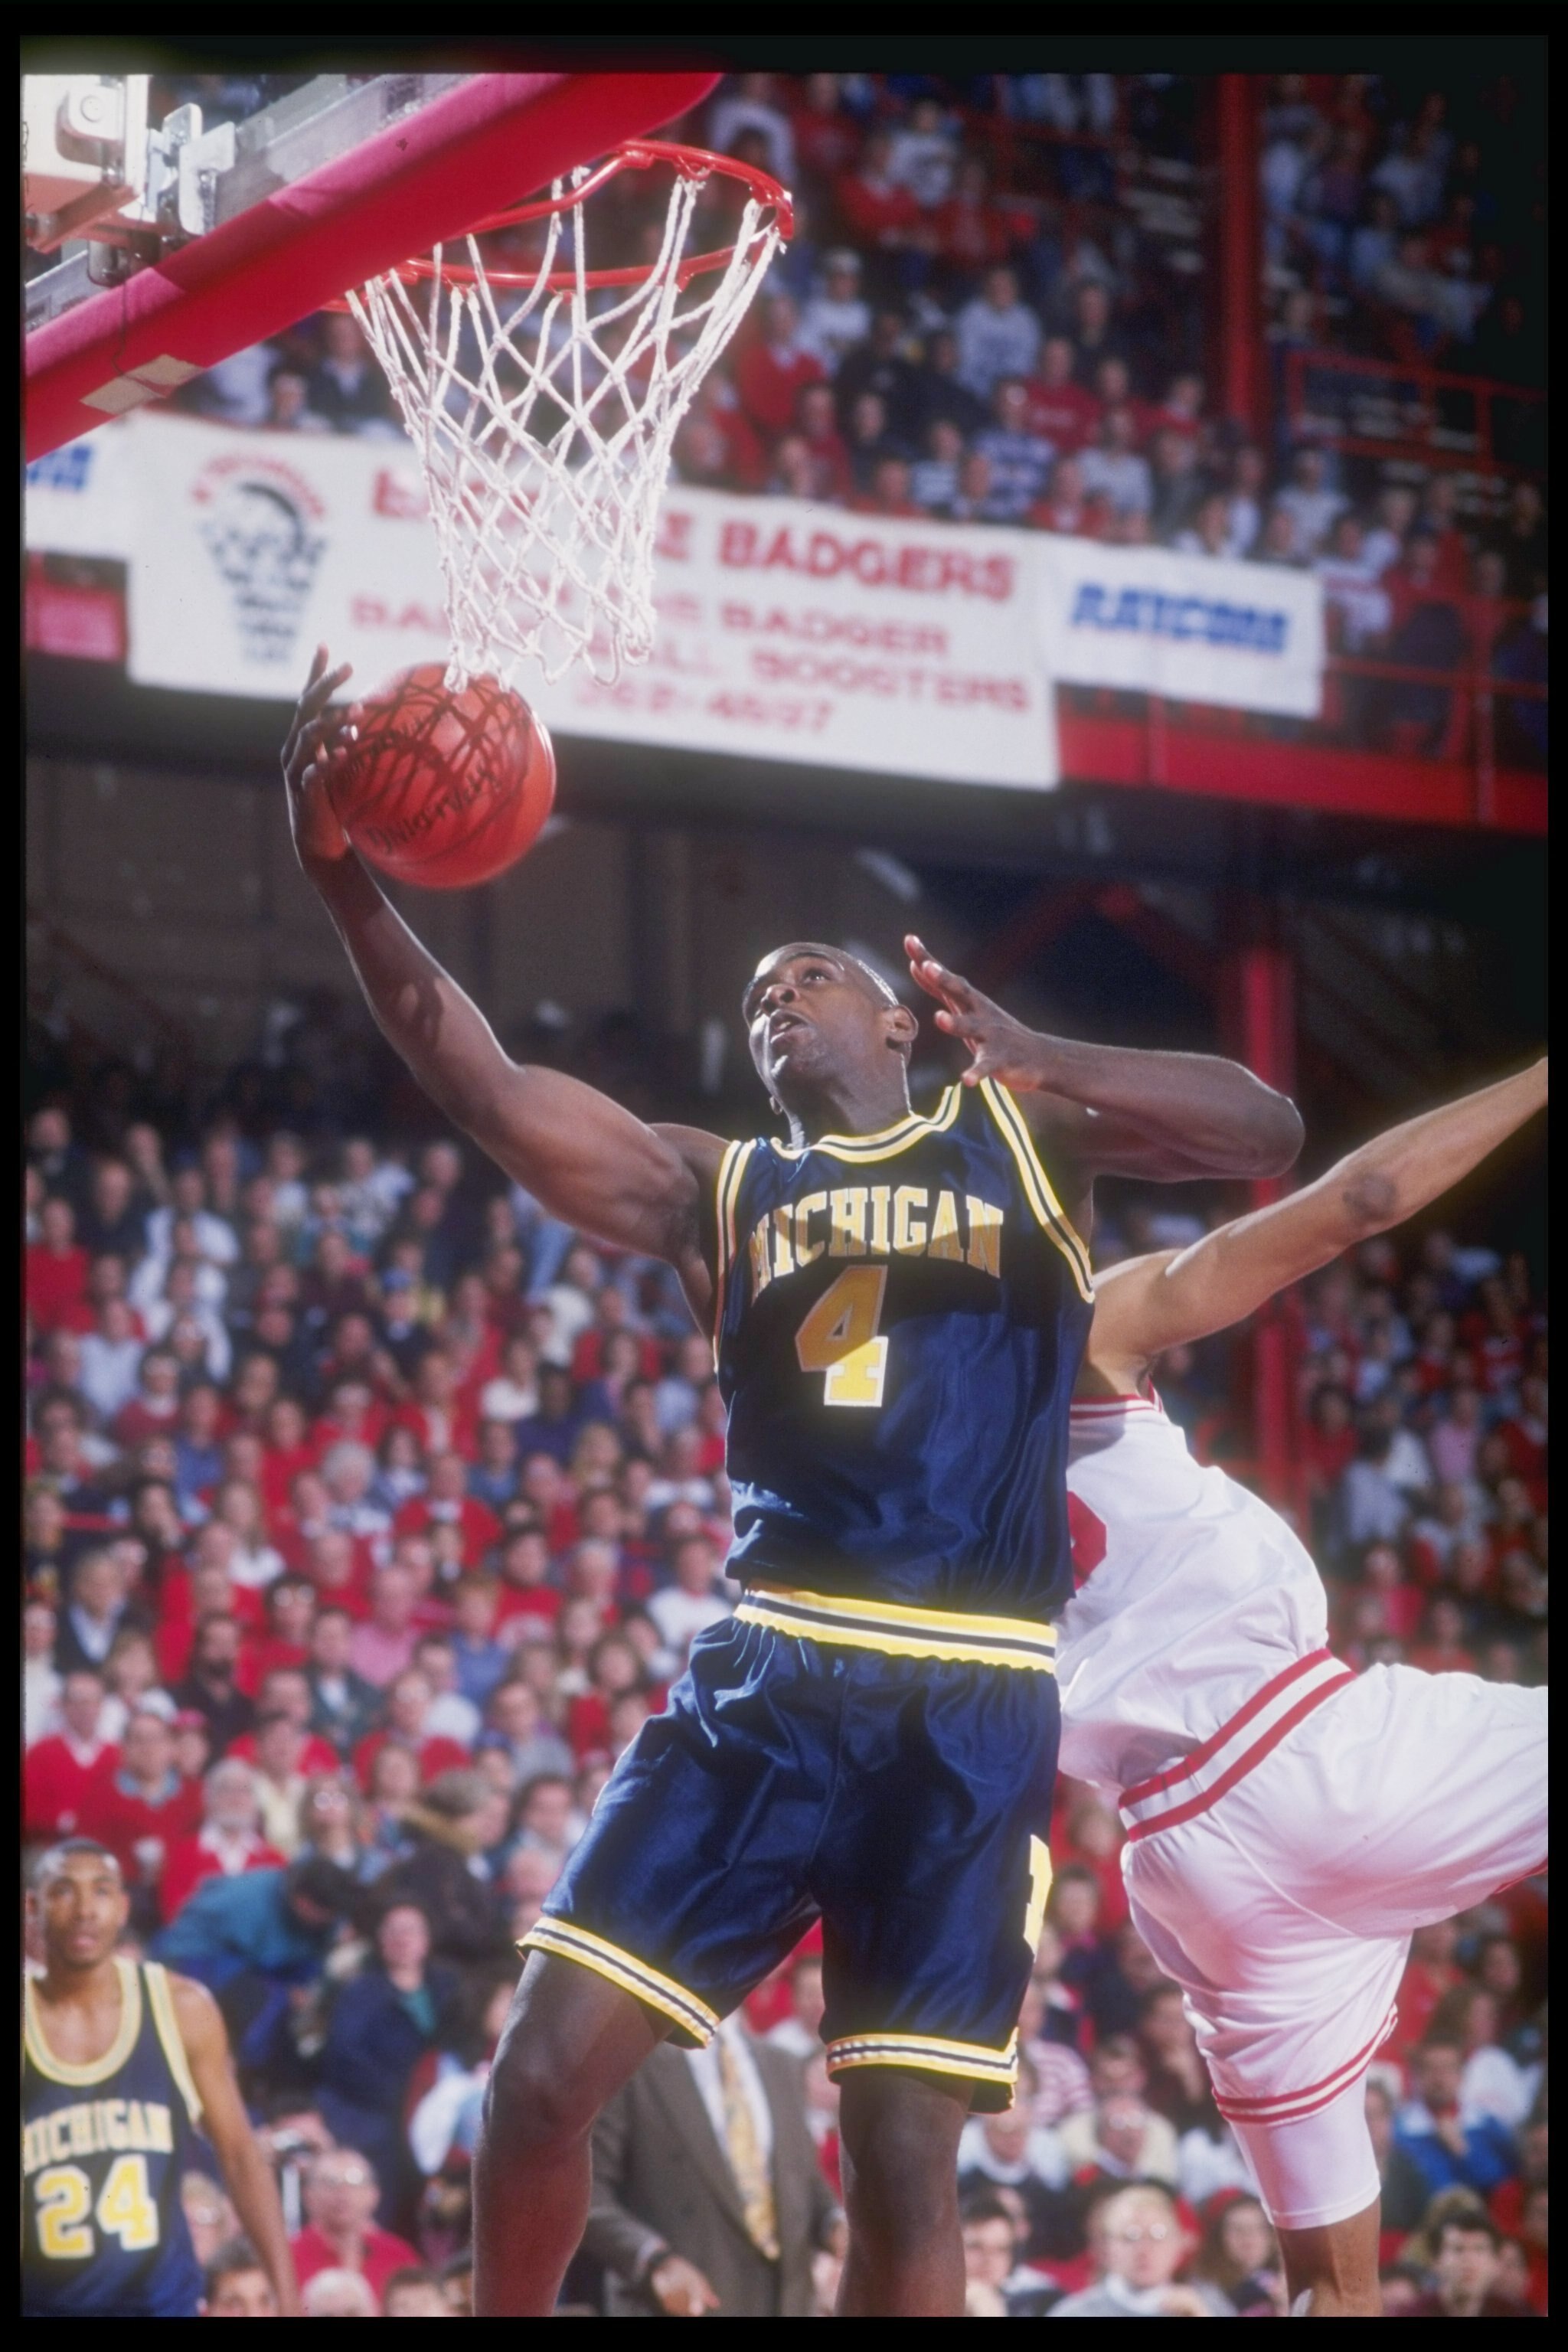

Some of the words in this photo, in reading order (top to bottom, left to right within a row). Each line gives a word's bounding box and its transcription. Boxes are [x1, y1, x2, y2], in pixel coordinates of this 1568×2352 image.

[720, 518, 1014, 603] BADGERS
[750, 1185, 1004, 1306] MICHIGAN
[795, 1265, 888, 1407] 4
[34, 2153, 160, 2259] 24
